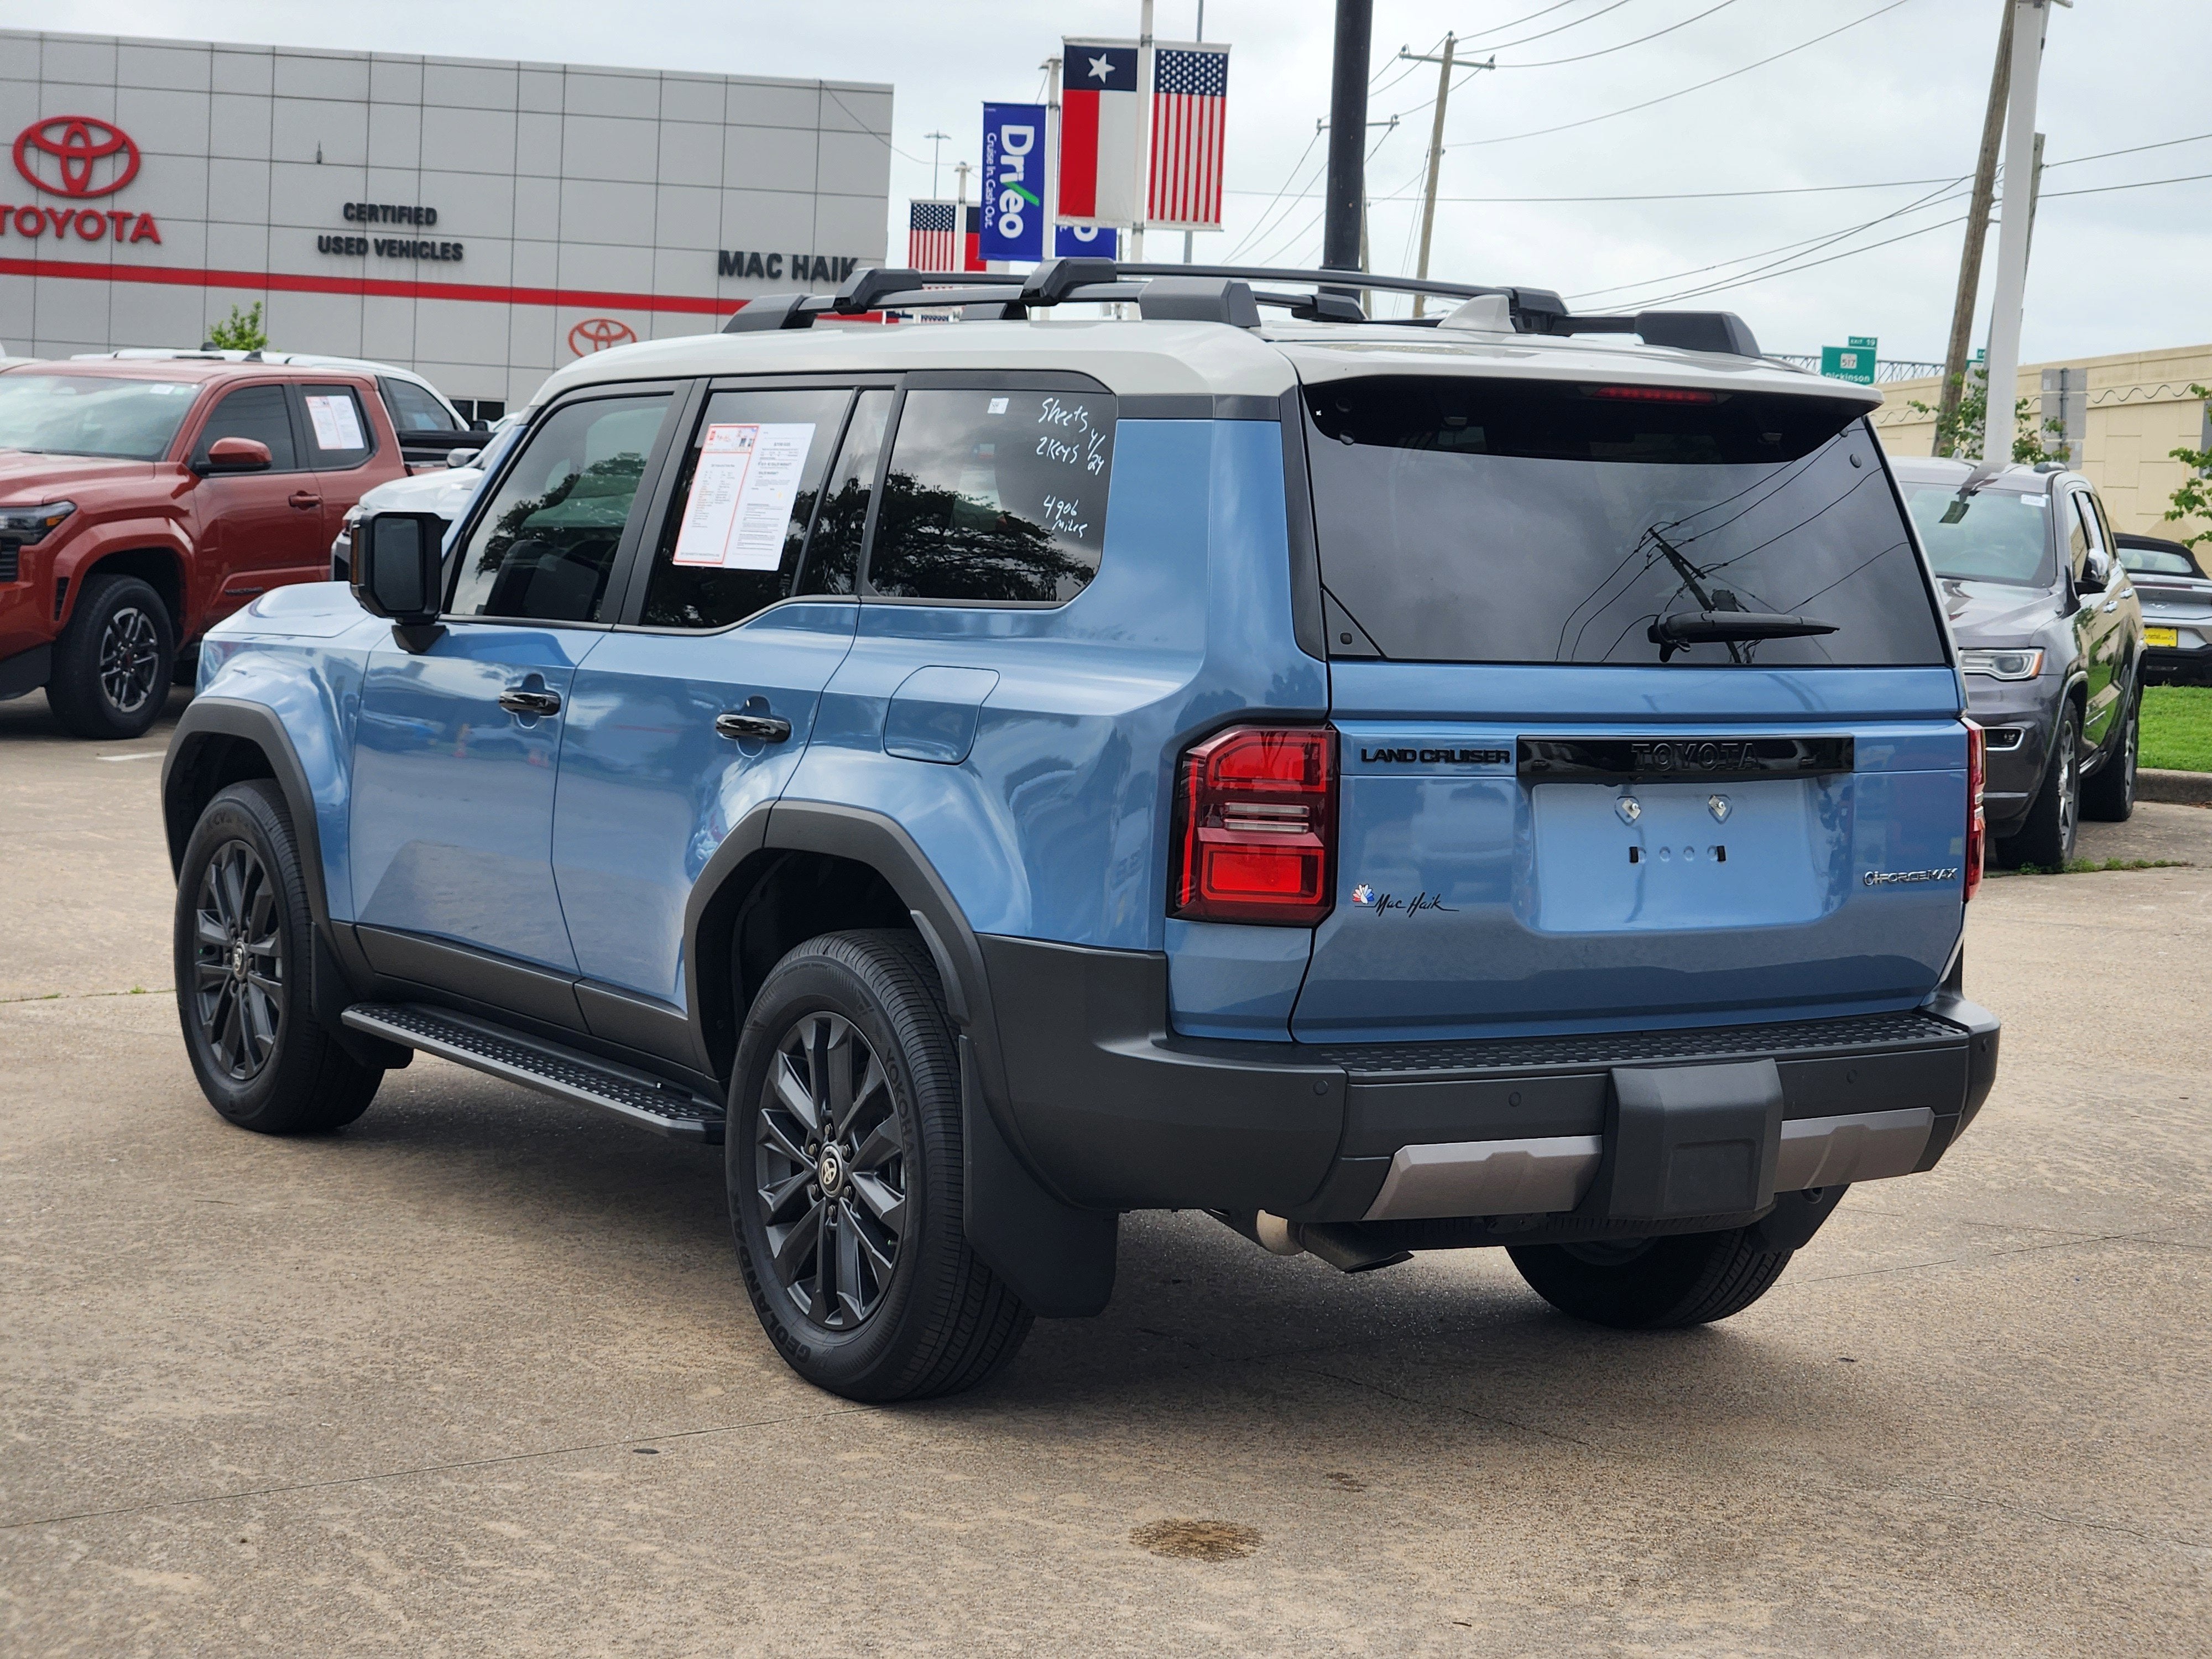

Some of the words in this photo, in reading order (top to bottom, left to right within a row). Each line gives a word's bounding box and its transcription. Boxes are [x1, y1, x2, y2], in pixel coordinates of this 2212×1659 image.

[987, 133, 997, 165] Cruise
[985, 179, 996, 205] Cash
[0, 204, 162, 244] TOYOTA
[343, 202, 437, 226] CERTIFIED
[317, 235, 369, 256] USED
[374, 238, 463, 261] VEHICLES
[719, 250, 783, 279] MAC
[791, 254, 858, 283] HAIK
[1842, 358, 1855, 367] 517
[1825, 372, 1871, 382] Dickinson
[1361, 748, 1417, 763] LAND
[1420, 748, 1510, 764] CRUISER
[1631, 743, 1761, 771] TOYOTA
